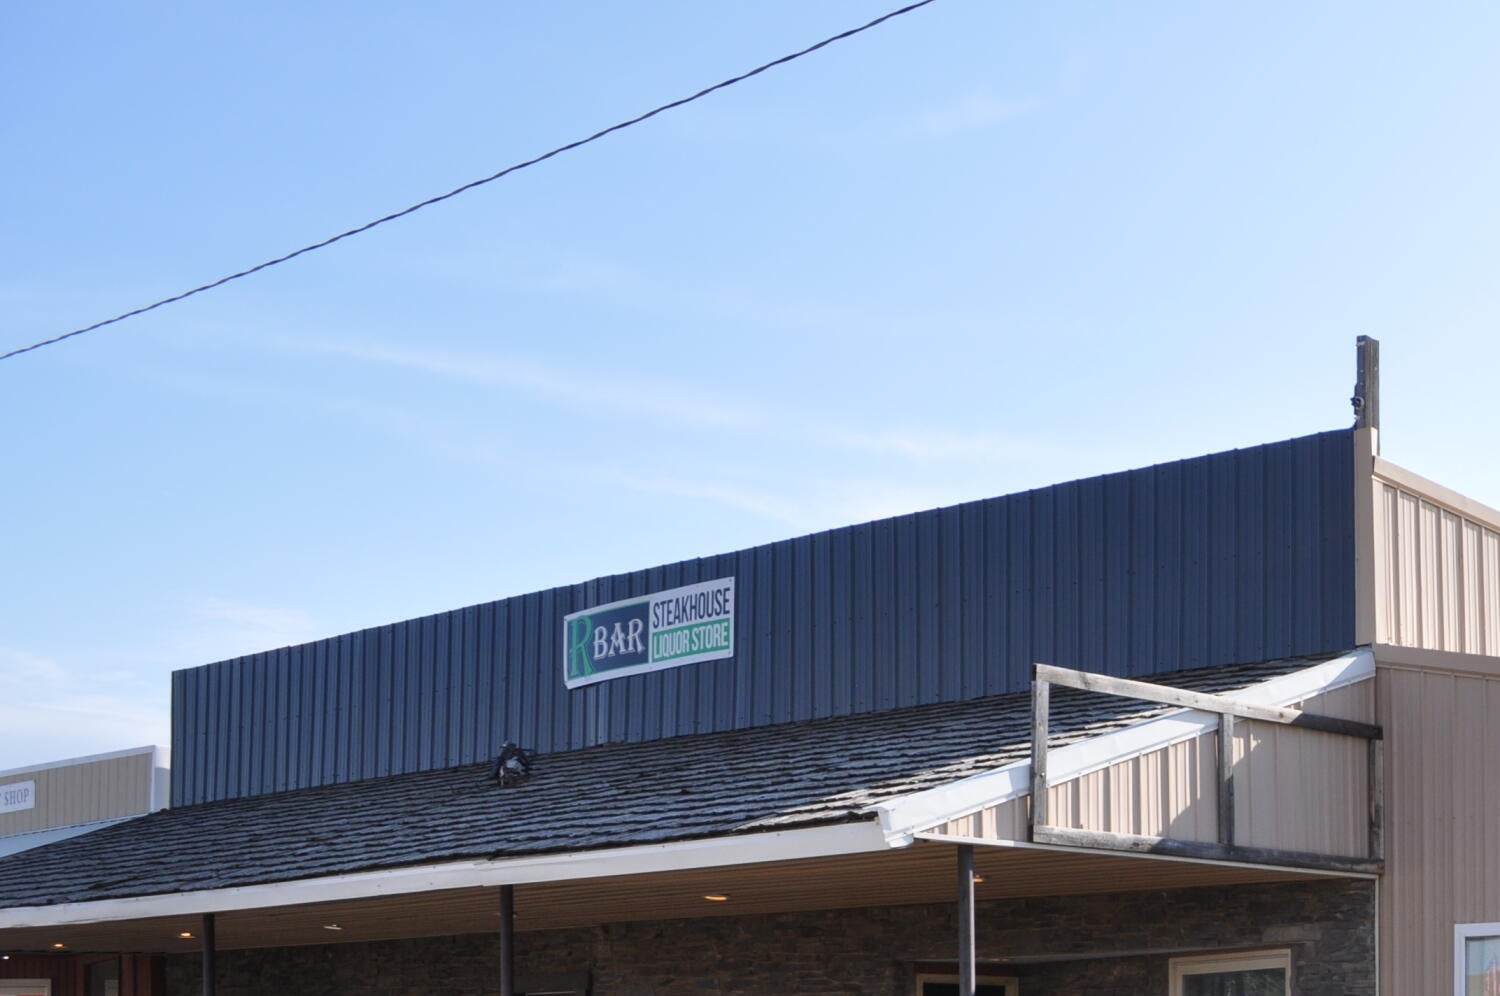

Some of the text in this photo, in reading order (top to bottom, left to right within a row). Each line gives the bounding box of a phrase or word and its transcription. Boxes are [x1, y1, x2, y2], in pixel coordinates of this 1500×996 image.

[652, 587, 731, 629] STEAKHOUSE
[568, 615, 646, 679] R BAR
[653, 621, 729, 660] LIQUOR STORE
[4, 787, 30, 806] SHOP
